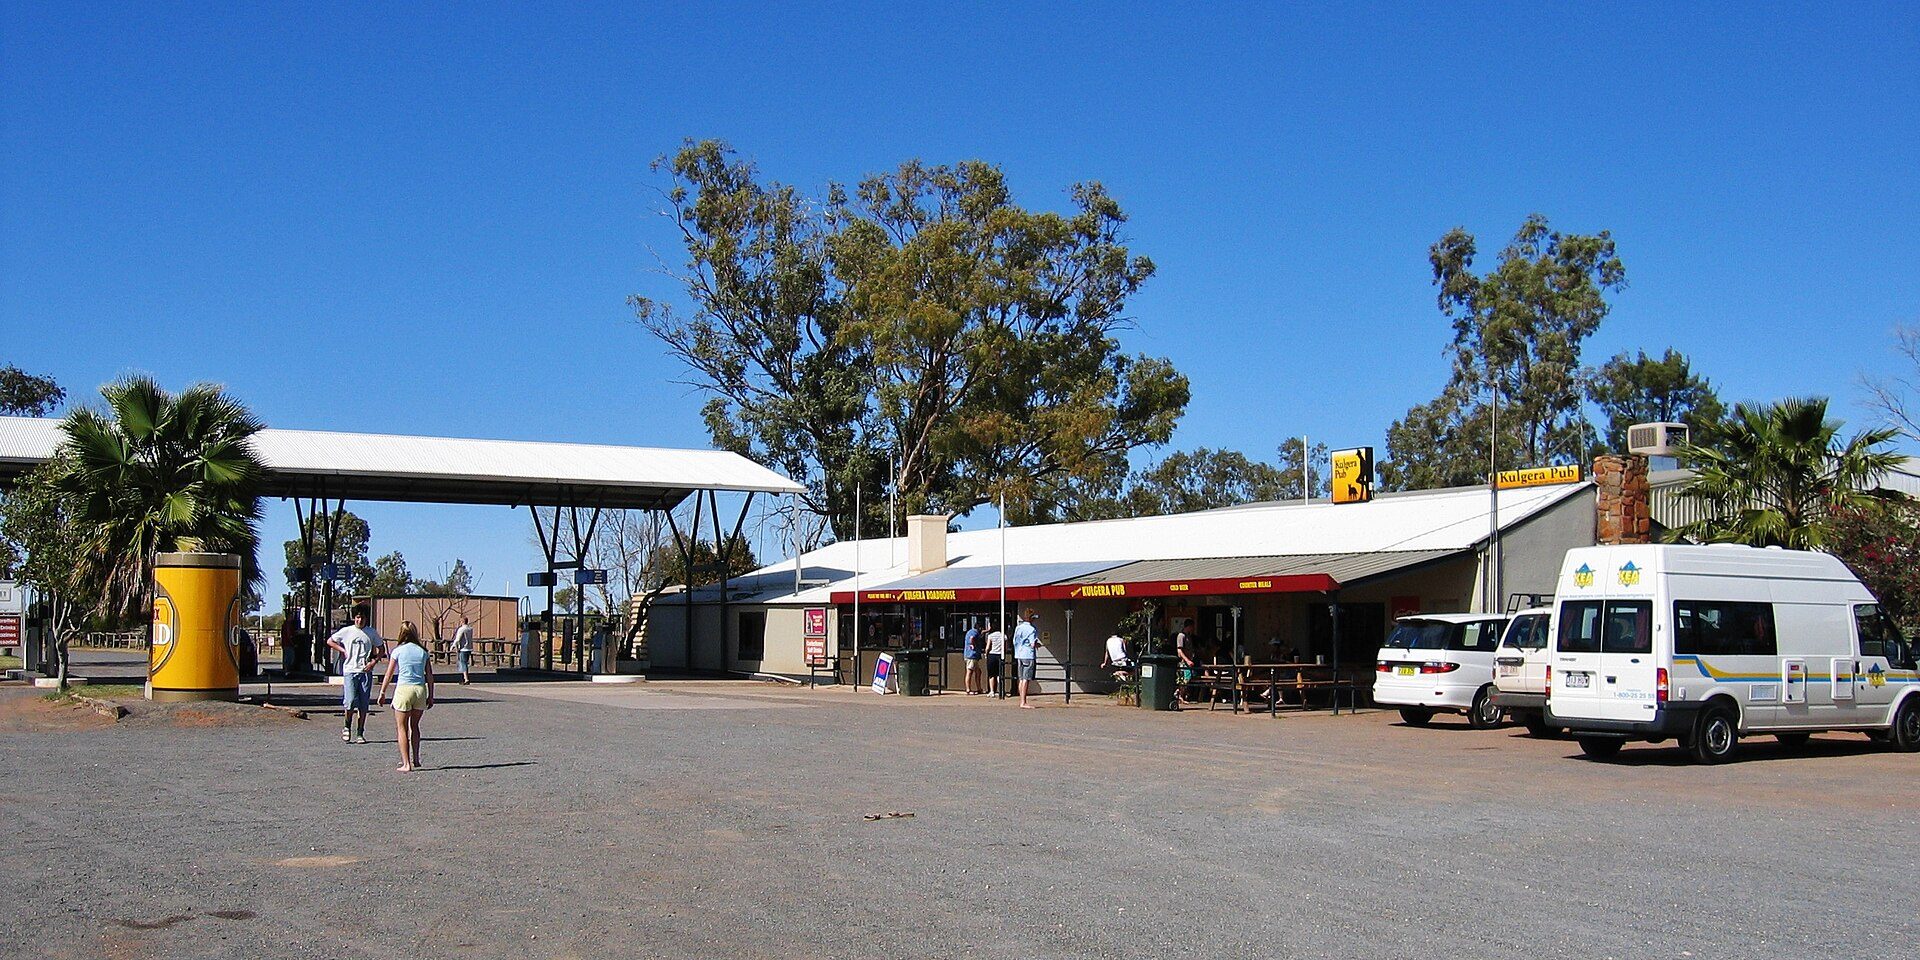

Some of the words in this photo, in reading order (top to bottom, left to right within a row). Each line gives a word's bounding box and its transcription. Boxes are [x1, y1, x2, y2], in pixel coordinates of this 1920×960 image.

[1335, 458, 1357, 470] Kulgera
[1335, 469, 1346, 478] Pub
[1500, 469, 1545, 484] Kulgera
[1551, 465, 1575, 478] Pub
[903, 591, 926, 600] KULGERA
[926, 590, 956, 600] ROADHOUSE
[1082, 585, 1110, 597] KULGERA
[1111, 584, 1125, 596] PUB
